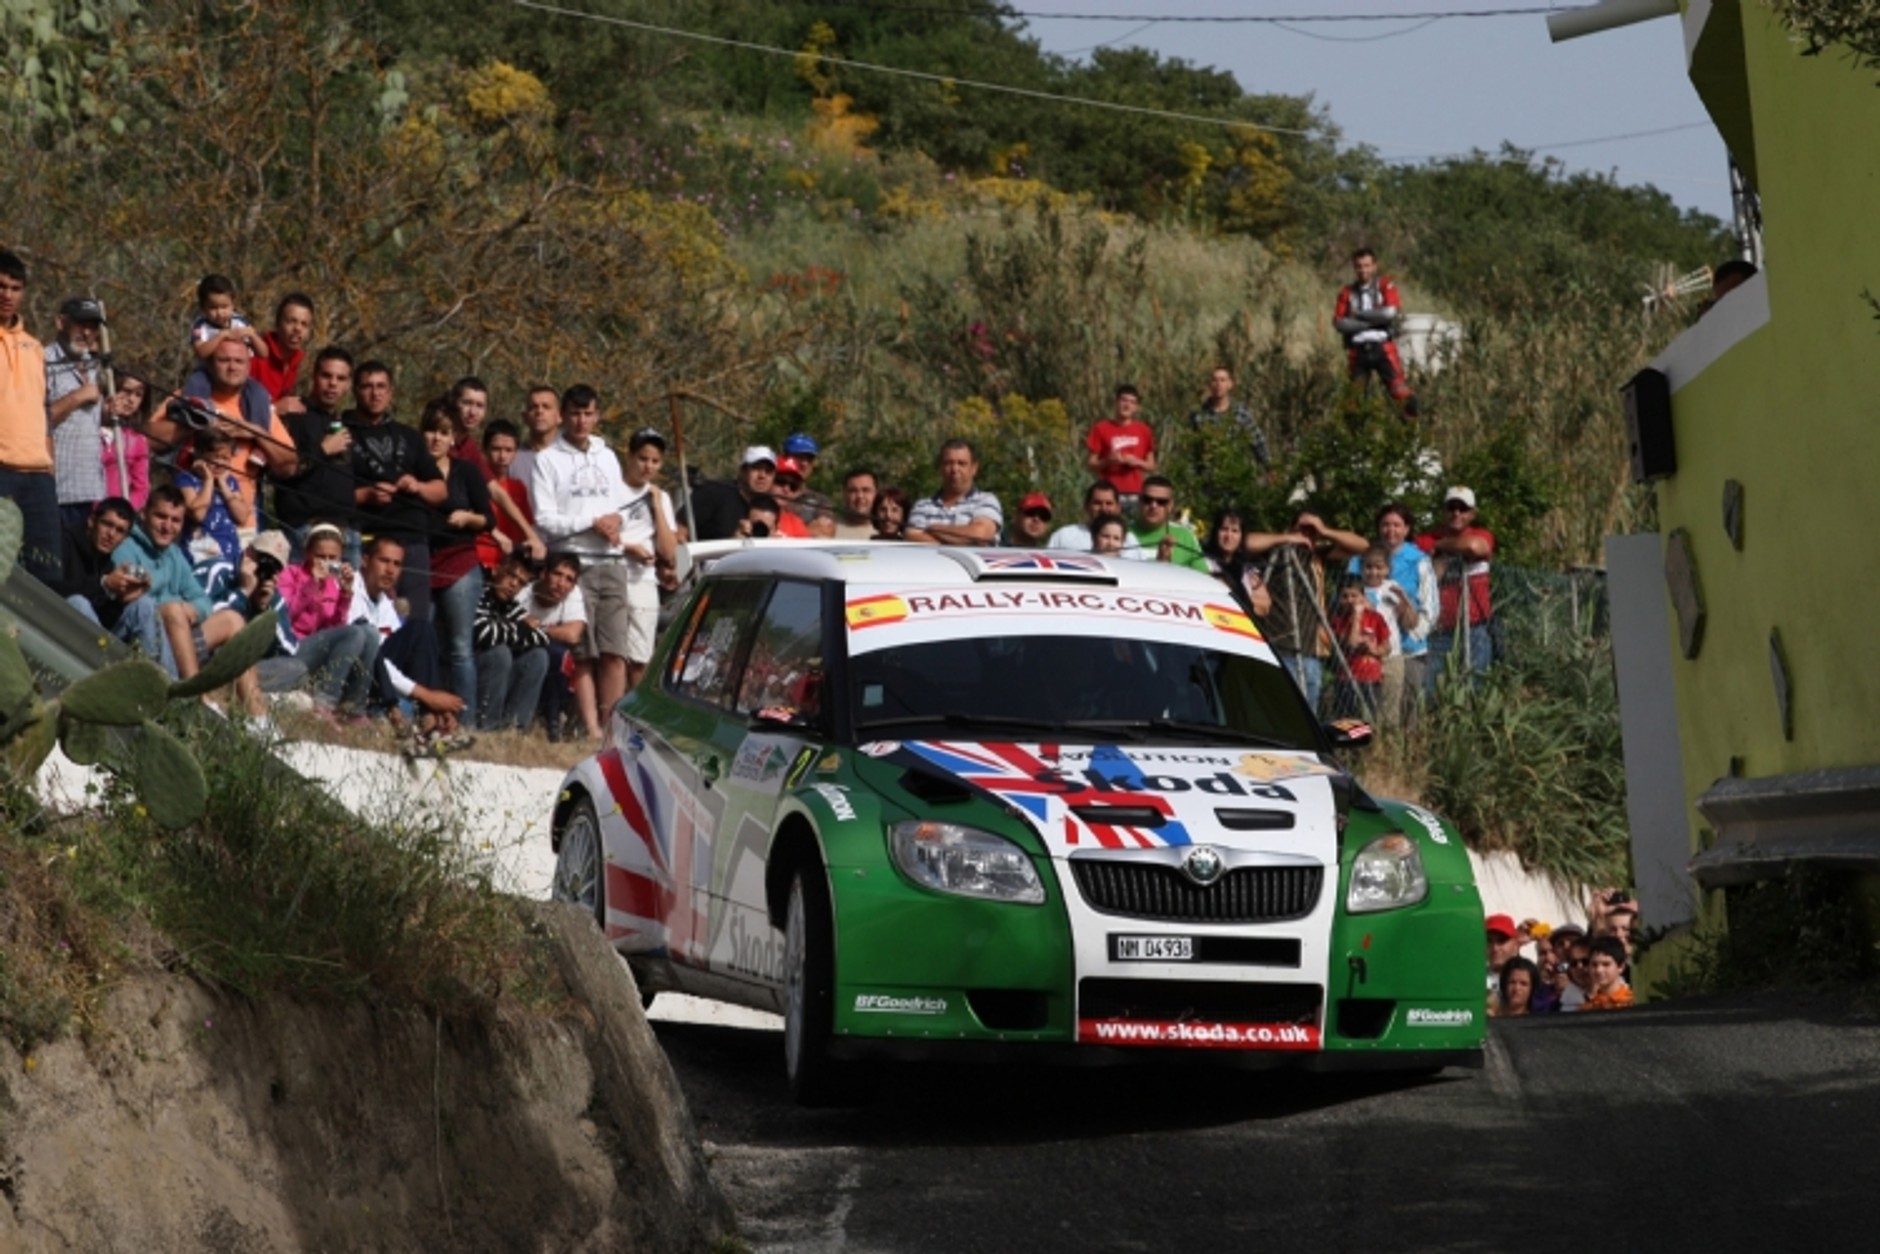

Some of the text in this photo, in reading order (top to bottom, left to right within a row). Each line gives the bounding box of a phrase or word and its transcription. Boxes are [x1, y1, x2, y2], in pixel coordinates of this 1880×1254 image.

[909, 592, 1205, 621] RALLY-IRC.COM
[854, 994, 947, 1011] BFGoodrich
[1096, 1022, 1309, 1043] www.skoda.co.uk
